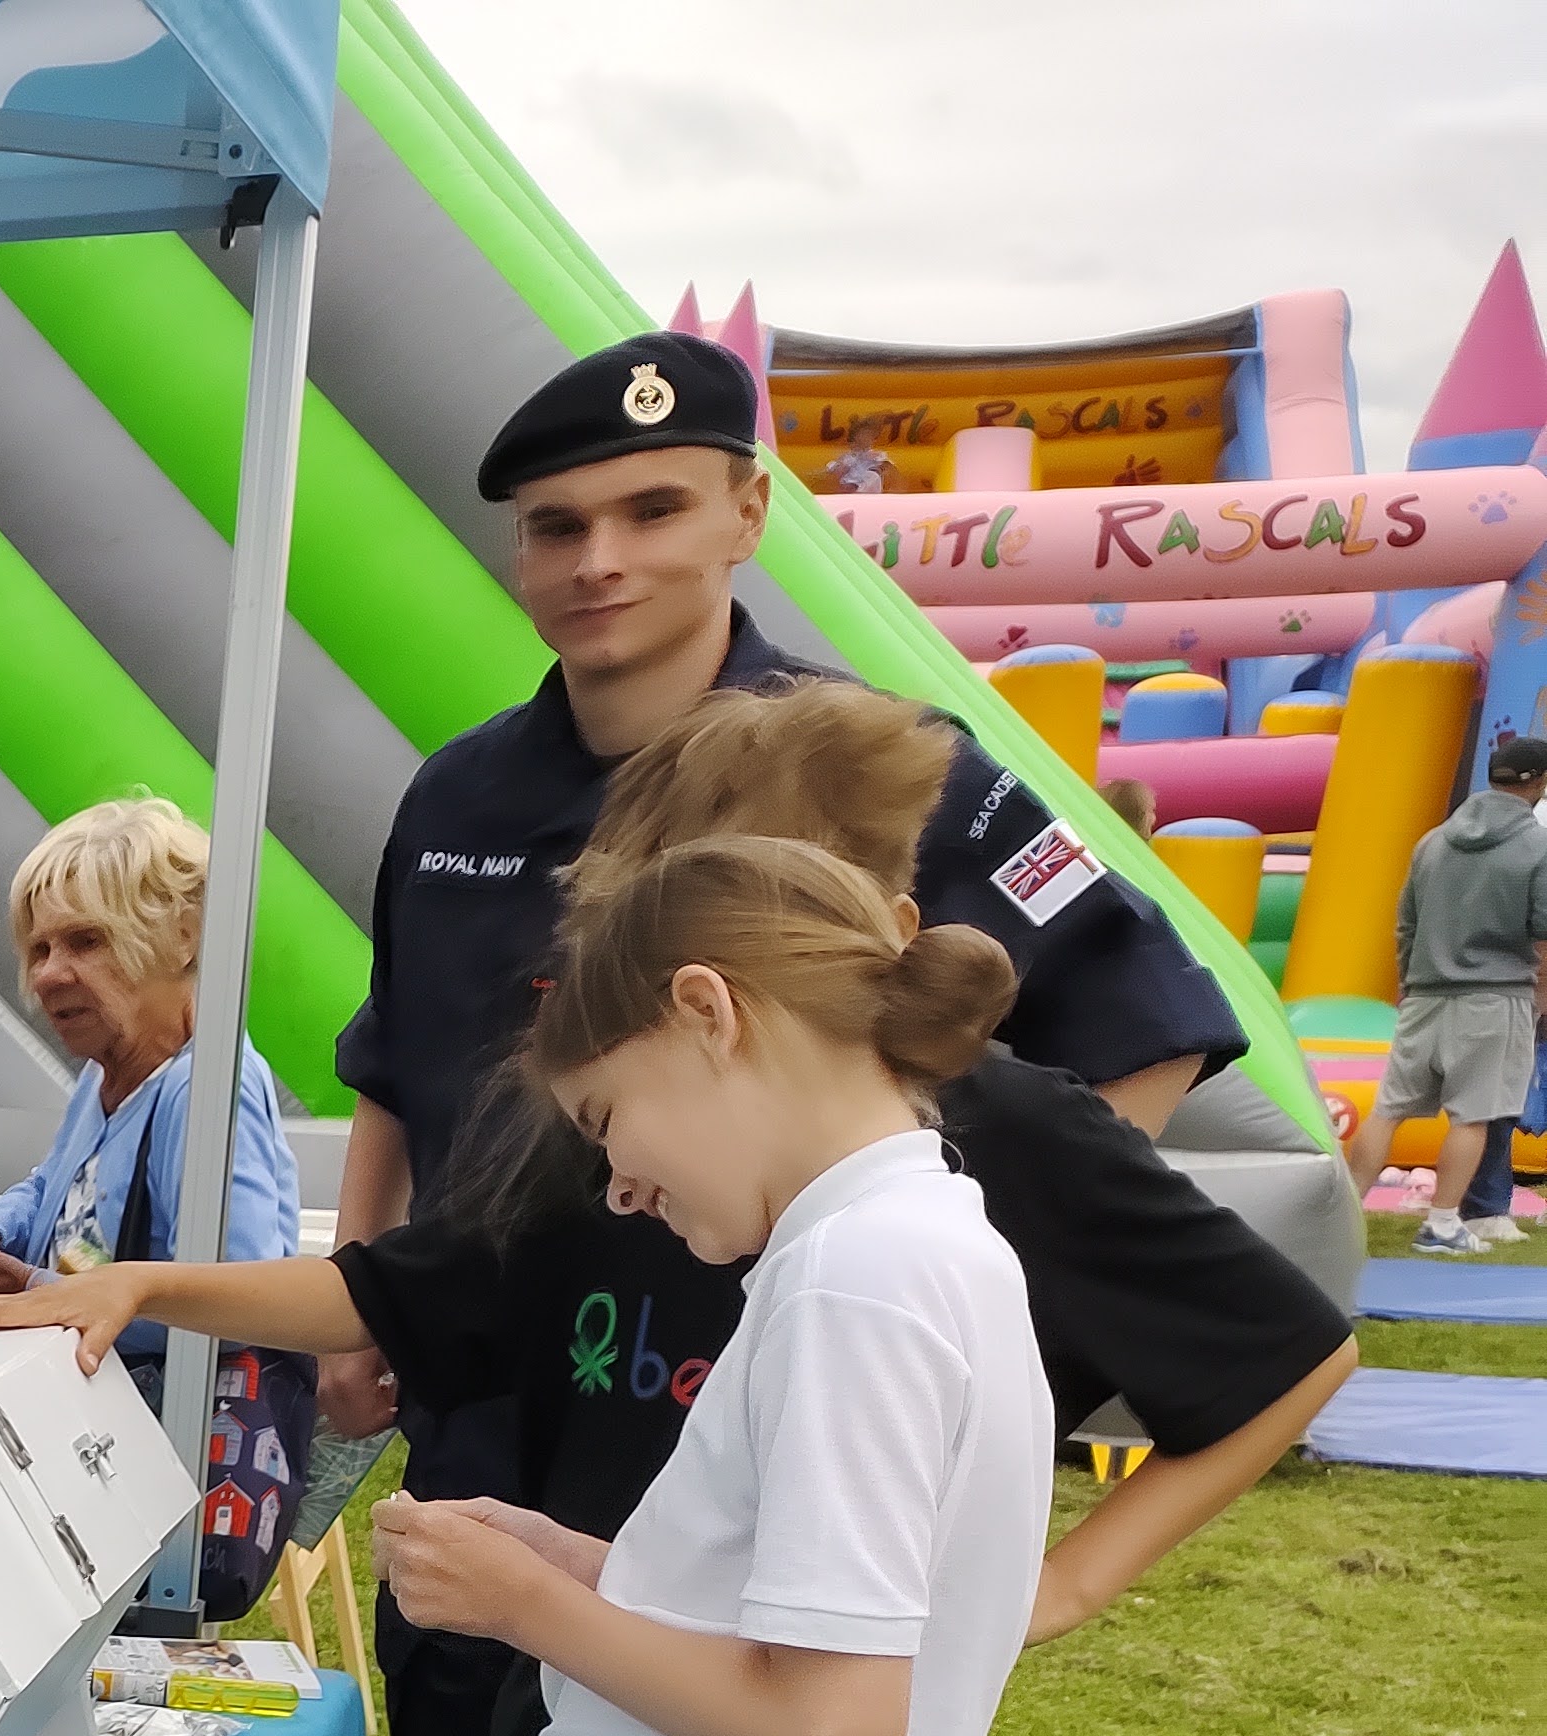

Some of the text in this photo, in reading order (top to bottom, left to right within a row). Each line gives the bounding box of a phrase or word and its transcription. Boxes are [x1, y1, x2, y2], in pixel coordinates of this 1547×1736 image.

[1095, 491, 1427, 568] RASCALS
[968, 770, 1018, 840] SEA CADE
[417, 851, 527, 877] ROYAL NAVY
